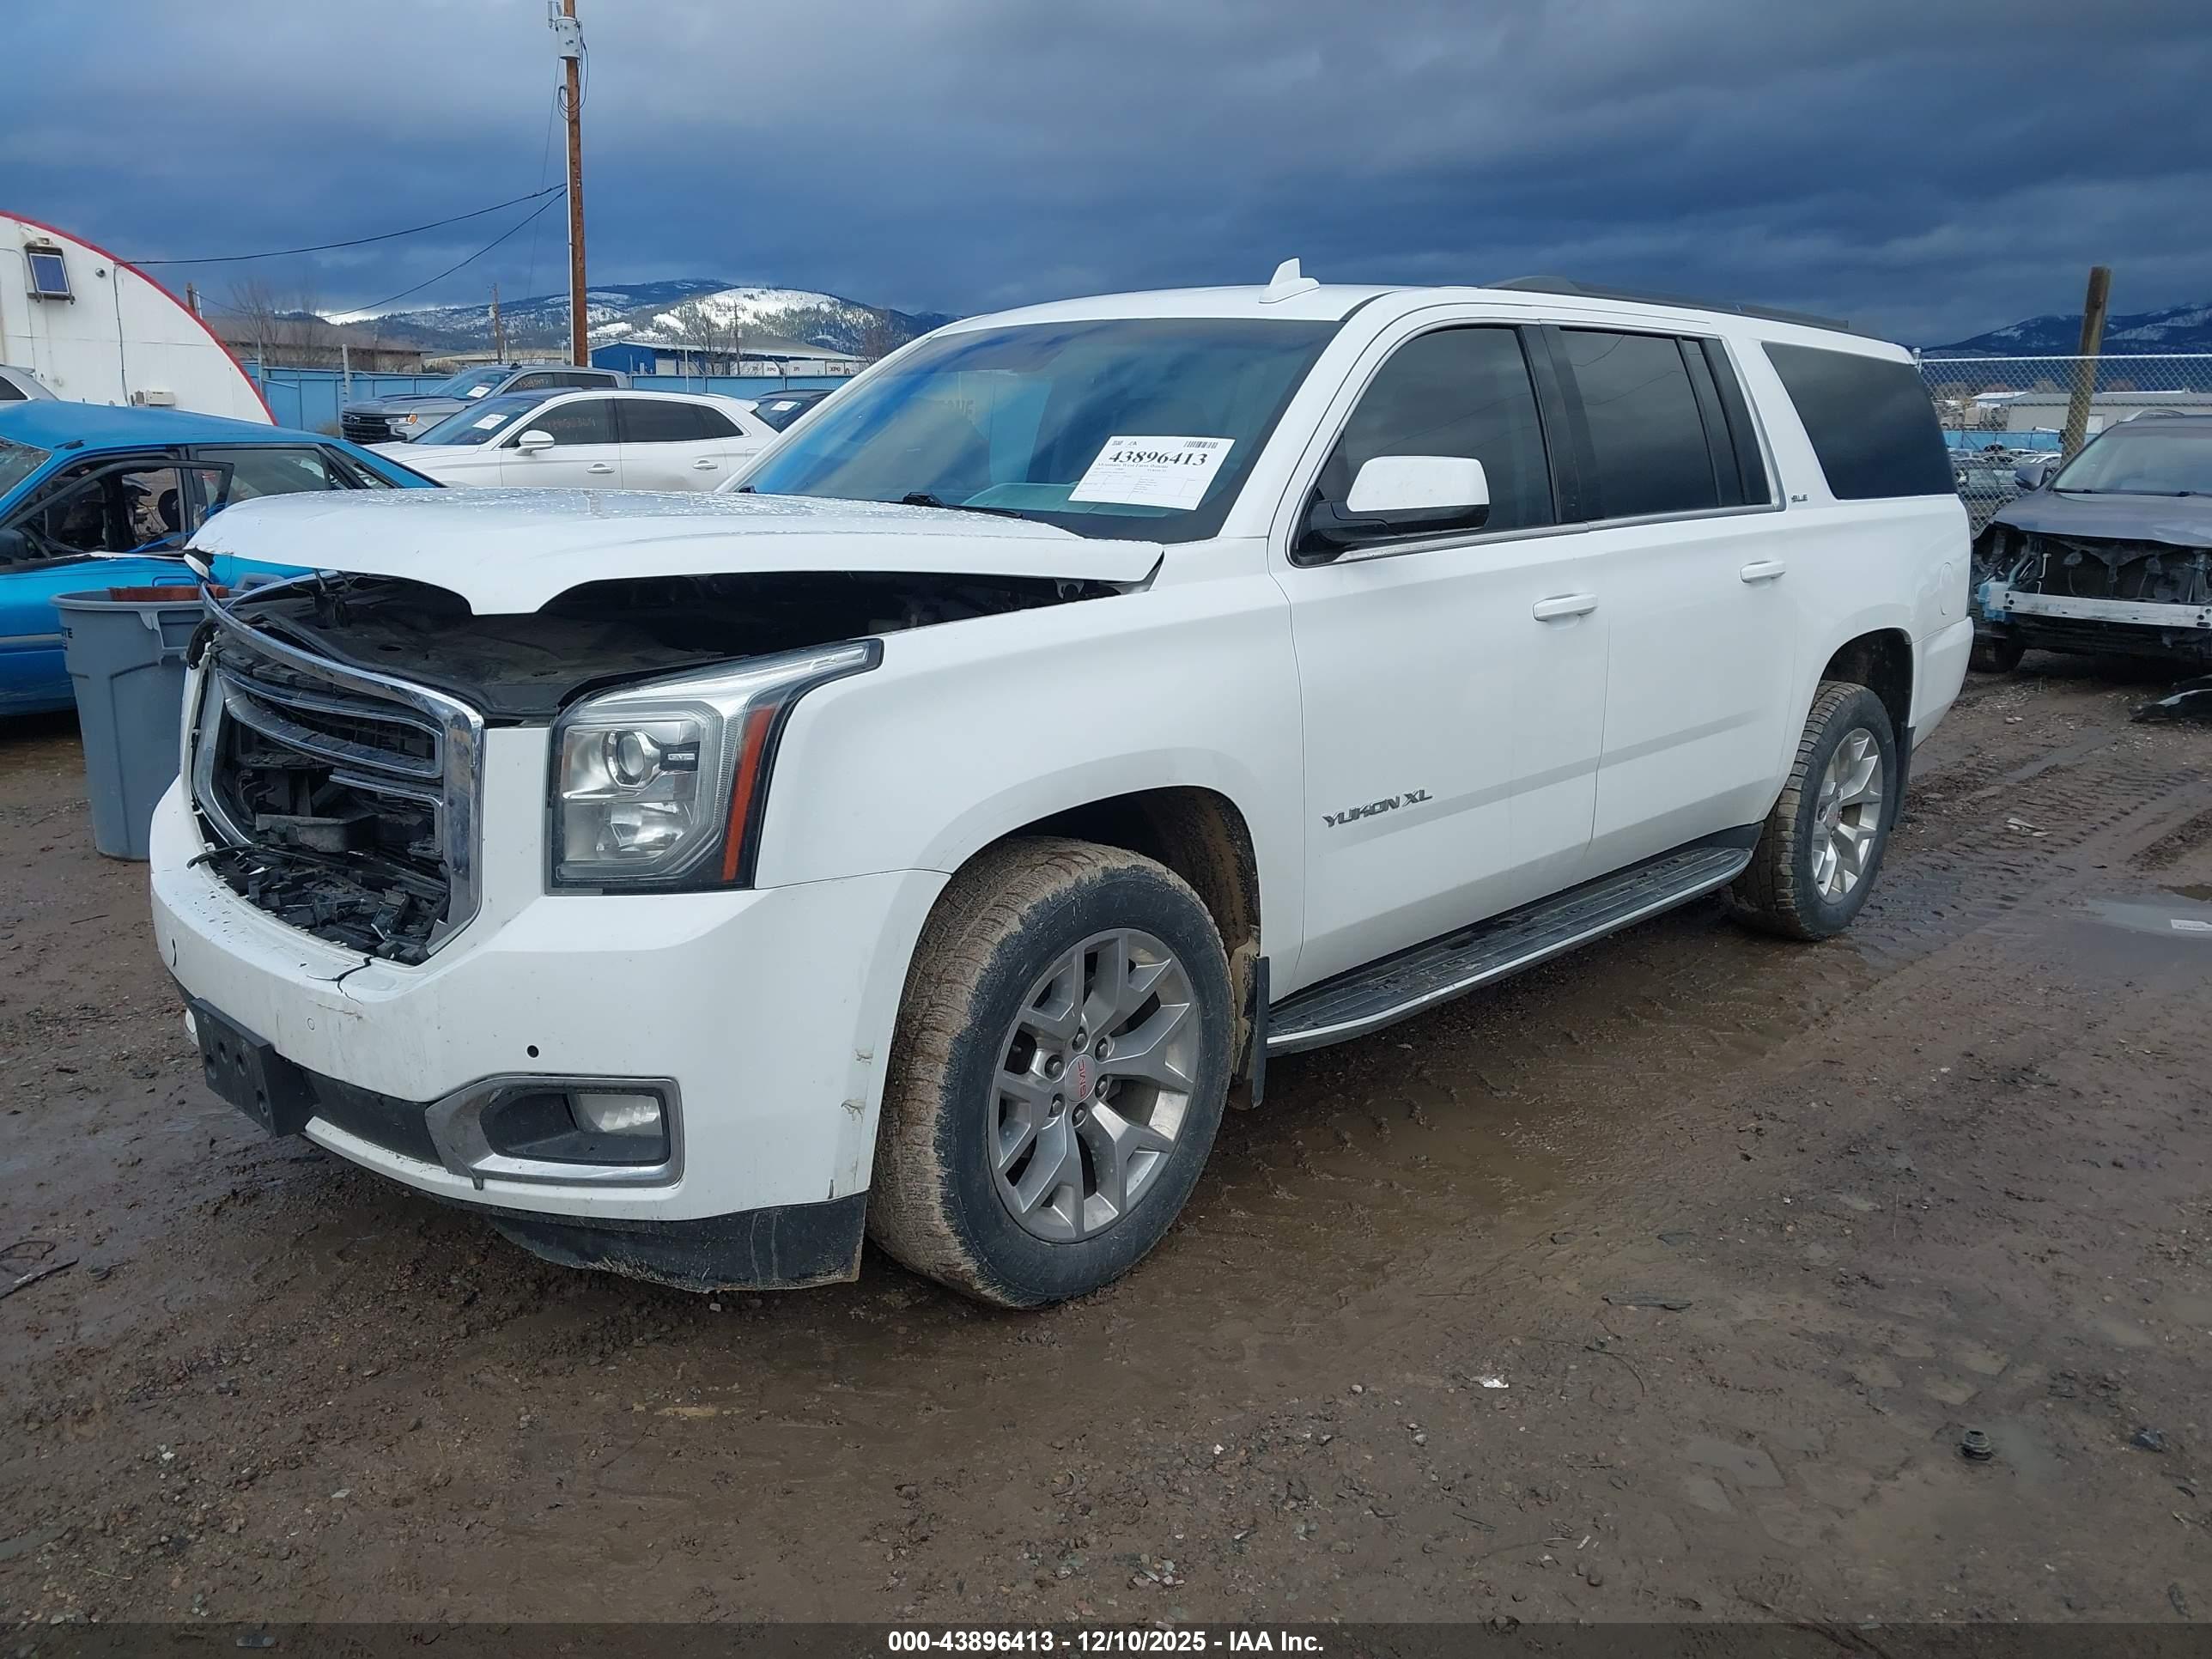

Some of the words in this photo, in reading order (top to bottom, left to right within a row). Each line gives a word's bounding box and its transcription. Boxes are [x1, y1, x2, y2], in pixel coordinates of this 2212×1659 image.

[1109, 450, 1208, 466] 43896413
[1322, 794, 1401, 828] YUKON
[1402, 789, 1433, 807] XL
[1078, 1059, 1086, 1099] GMC
